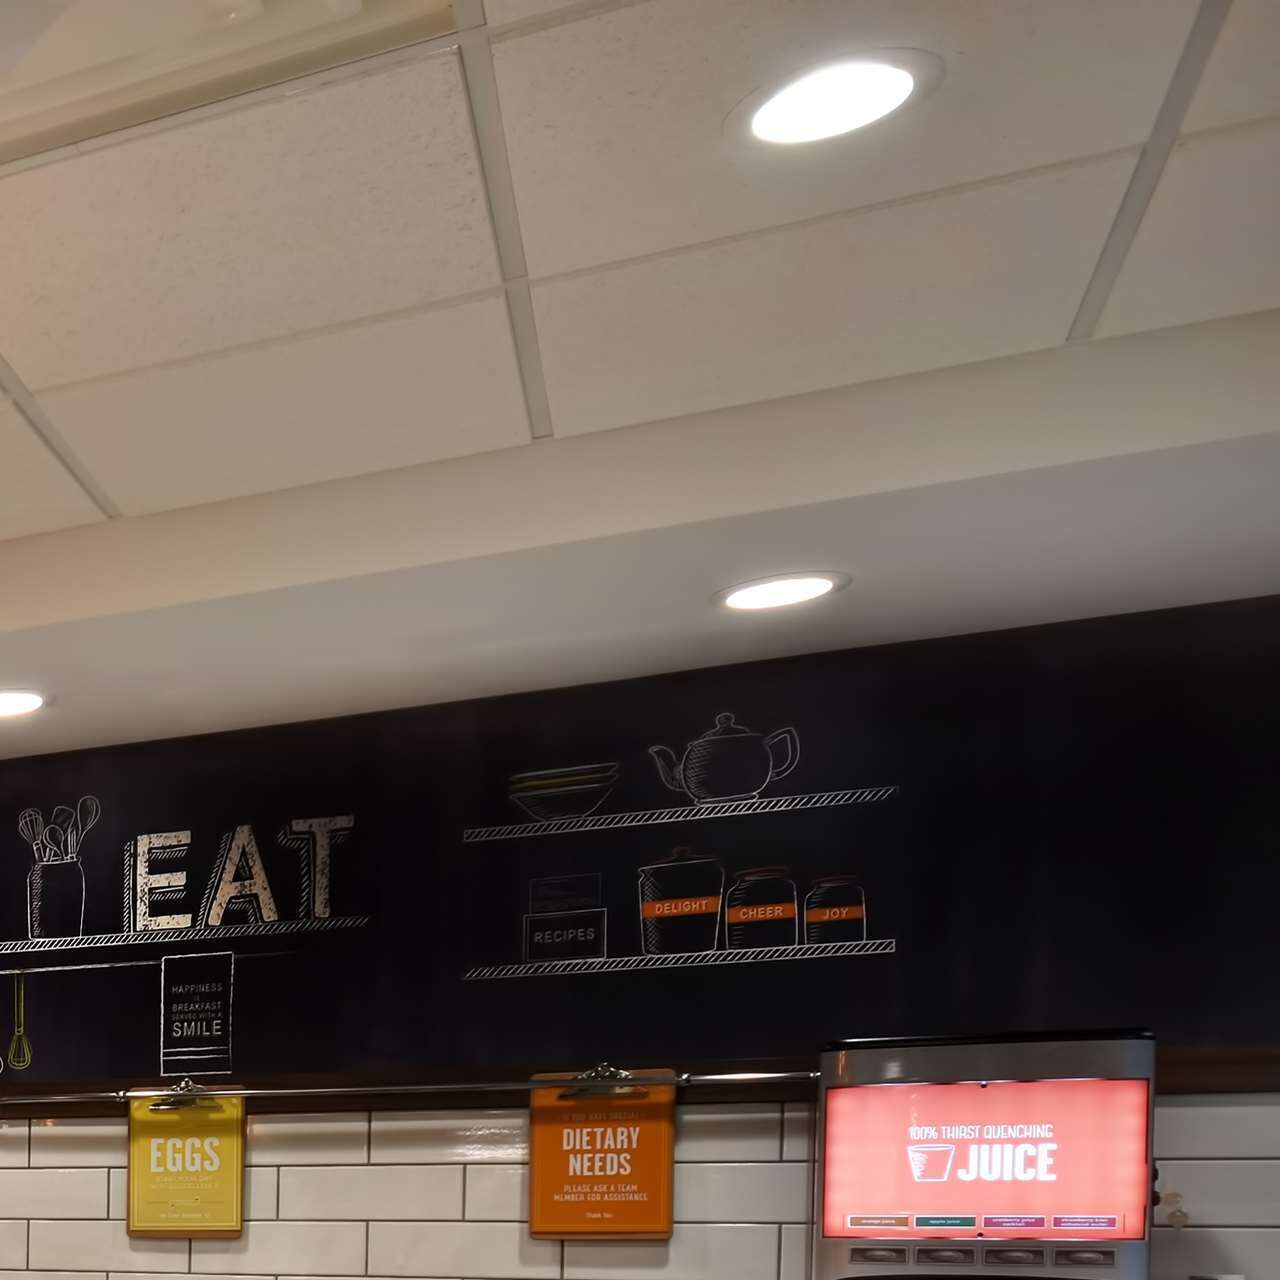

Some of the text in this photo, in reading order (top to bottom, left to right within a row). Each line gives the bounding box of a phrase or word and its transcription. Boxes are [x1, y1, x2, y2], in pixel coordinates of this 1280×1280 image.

[125, 815, 355, 932] EAT
[655, 900, 708, 914] DELIGHT
[740, 906, 783, 919] CHEER
[823, 907, 848, 919] JOY
[534, 927, 596, 943] RECIPES
[171, 982, 223, 993] HAPPINESS
[171, 1001, 222, 1013] BREAKFAST
[172, 1020, 222, 1037] SMILE
[562, 1127, 640, 1150] DIETARY
[909, 1123, 1054, 1140] 100% THIRST QUENCHING
[150, 1136, 221, 1173] EGGS
[956, 1142, 1058, 1182] JUICE
[568, 1153, 632, 1176] NEEDS
[563, 1184, 638, 1193] PLEASE ASK A TEAM
[554, 1193, 648, 1201] MEMBER FOR ASSISTANCE
